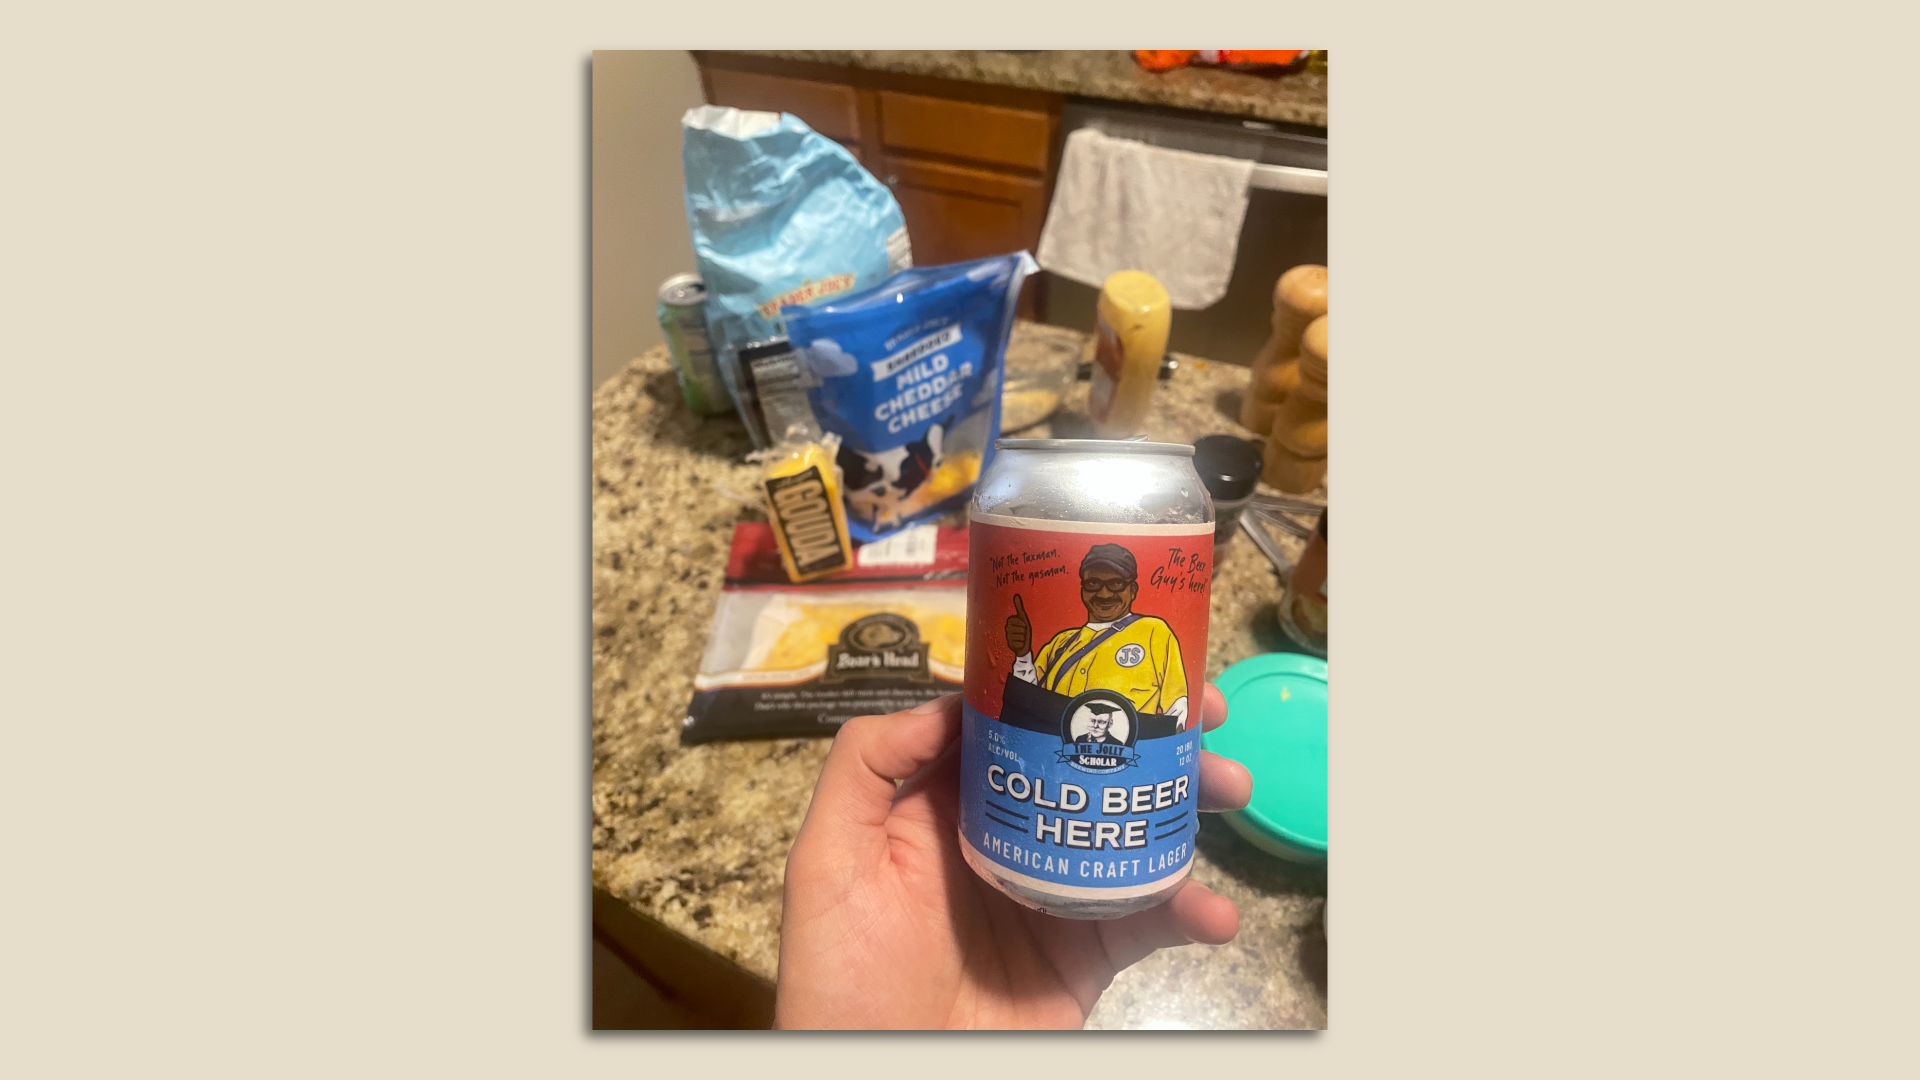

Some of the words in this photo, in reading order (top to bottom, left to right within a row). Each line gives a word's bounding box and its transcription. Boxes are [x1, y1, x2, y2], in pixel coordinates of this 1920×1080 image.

[896, 353, 949, 391] MILD
[874, 361, 973, 421] CHEDDAR
[887, 383, 963, 434] CHEESE
[774, 479, 840, 567] GOUDA
[1007, 553, 1019, 567] the
[1022, 548, 1060, 564] taxman.
[1168, 548, 1186, 569] The
[1187, 553, 1206, 574] Beer
[996, 573, 1010, 588] Not
[1012, 570, 1024, 583] the
[1029, 565, 1069, 586] gasman.
[1151, 566, 1186, 593] Guy's
[1118, 647, 1142, 665] JS
[988, 742, 1020, 762] ALC/VOL
[1073, 743, 1093, 754] THE
[1096, 743, 1125, 756] JOLLY
[1079, 754, 1117, 767] SCHOLAR
[1176, 744, 1184, 756] 20
[1179, 756, 1185, 766] 12
[1070, 761, 1097, 775] BREWING
[1097, 764, 1126, 775] COMPANY
[986, 764, 1089, 814] COLD
[1101, 774, 1190, 816] BEER
[1035, 812, 1149, 850] HERE
[983, 832, 1069, 876] AMERICAN
[1079, 858, 1141, 878] CRAFT
[1149, 842, 1187, 874] LAGER
